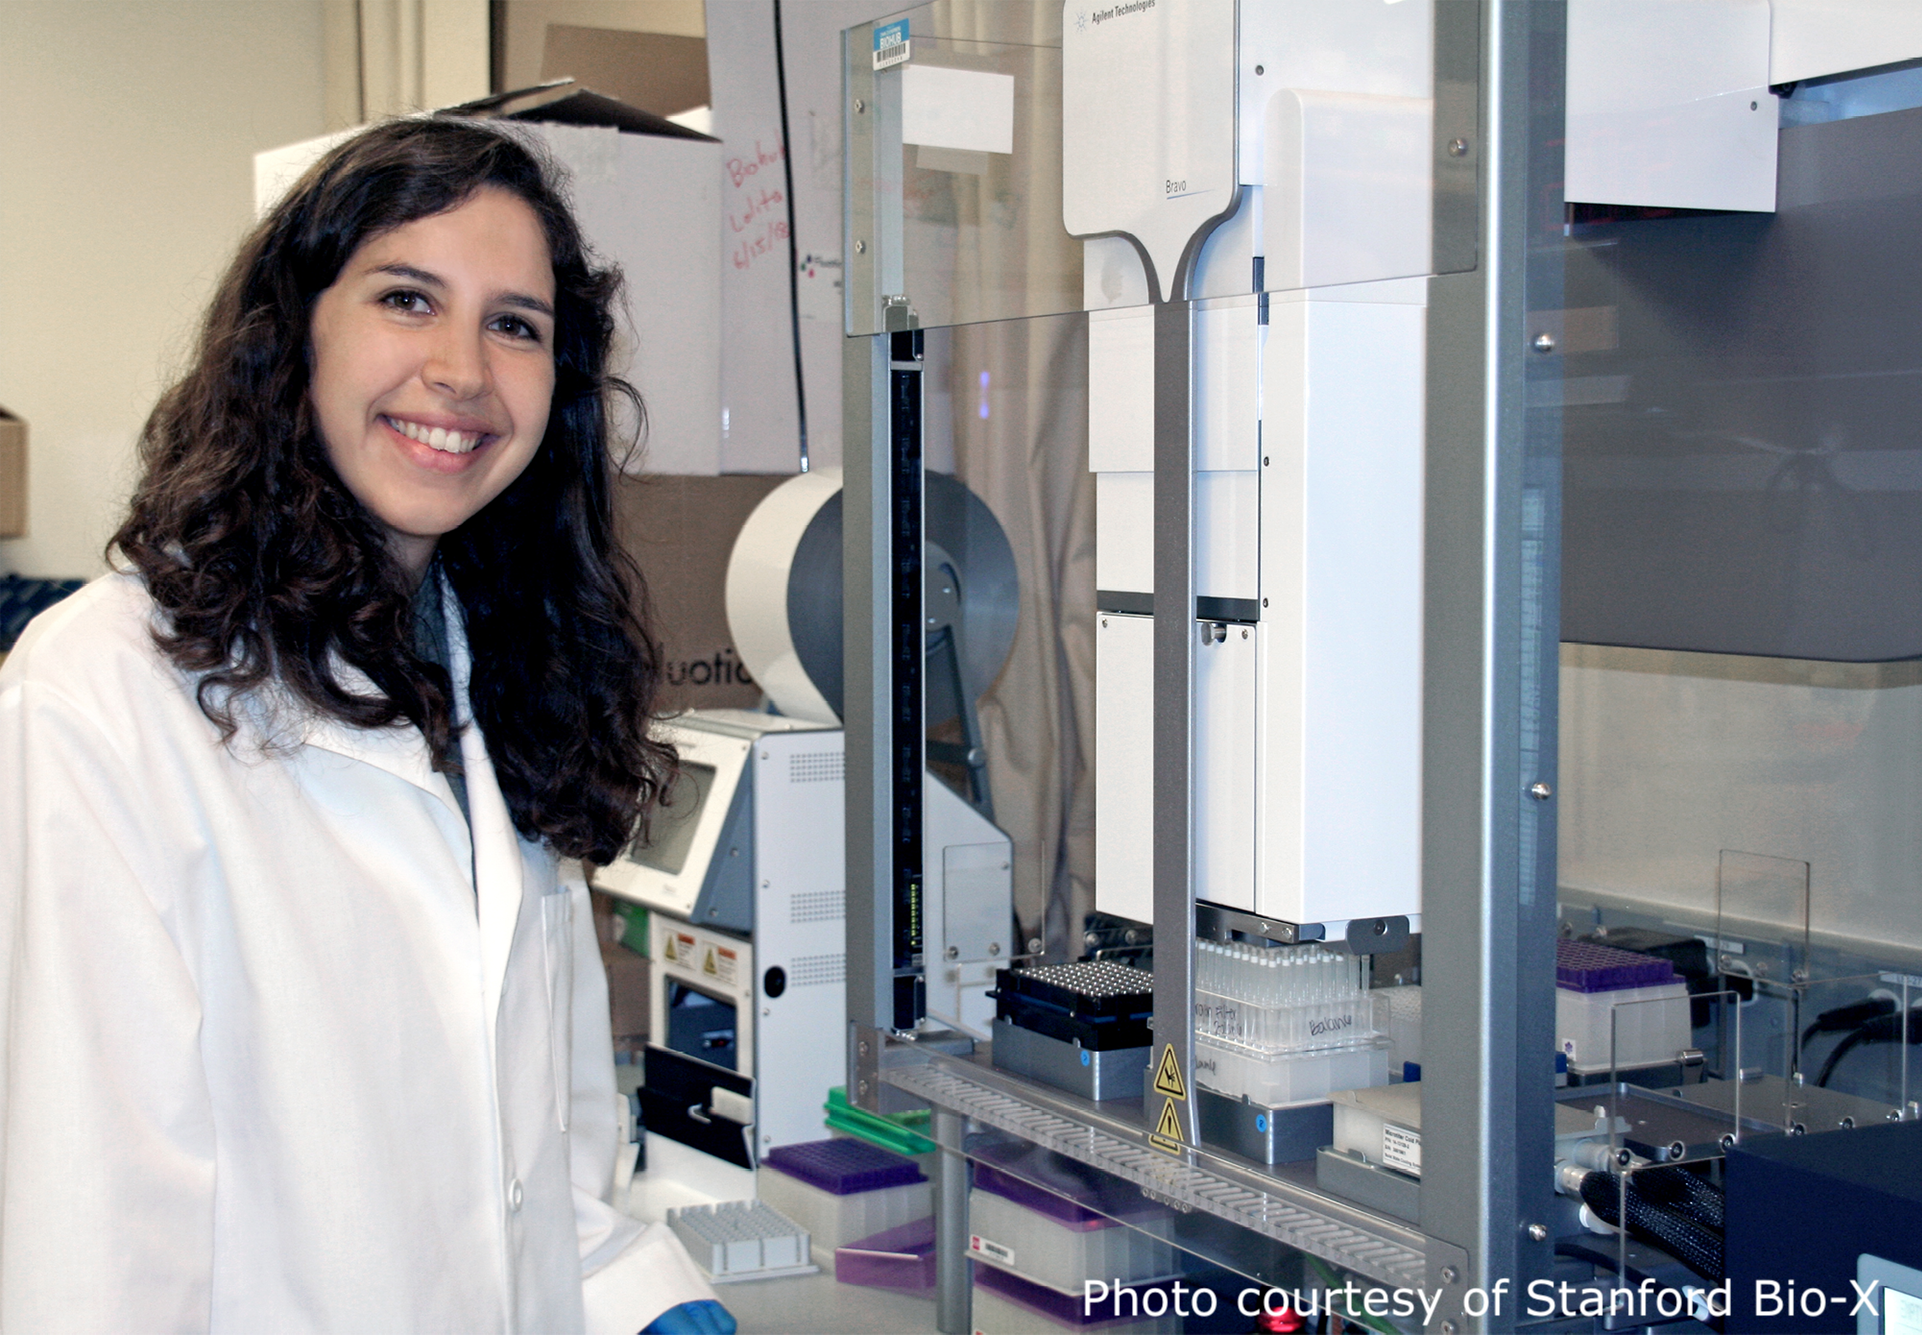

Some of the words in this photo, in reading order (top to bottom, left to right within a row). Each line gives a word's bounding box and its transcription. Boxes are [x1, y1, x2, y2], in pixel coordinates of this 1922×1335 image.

[1091, 9, 1114, 25] Agilent
[1115, 0, 1155, 17] Technologies
[880, 32, 902, 50] BIOHUB
[1165, 180, 1187, 193] Bravo
[1405, 1135, 1415, 1144] Cold
